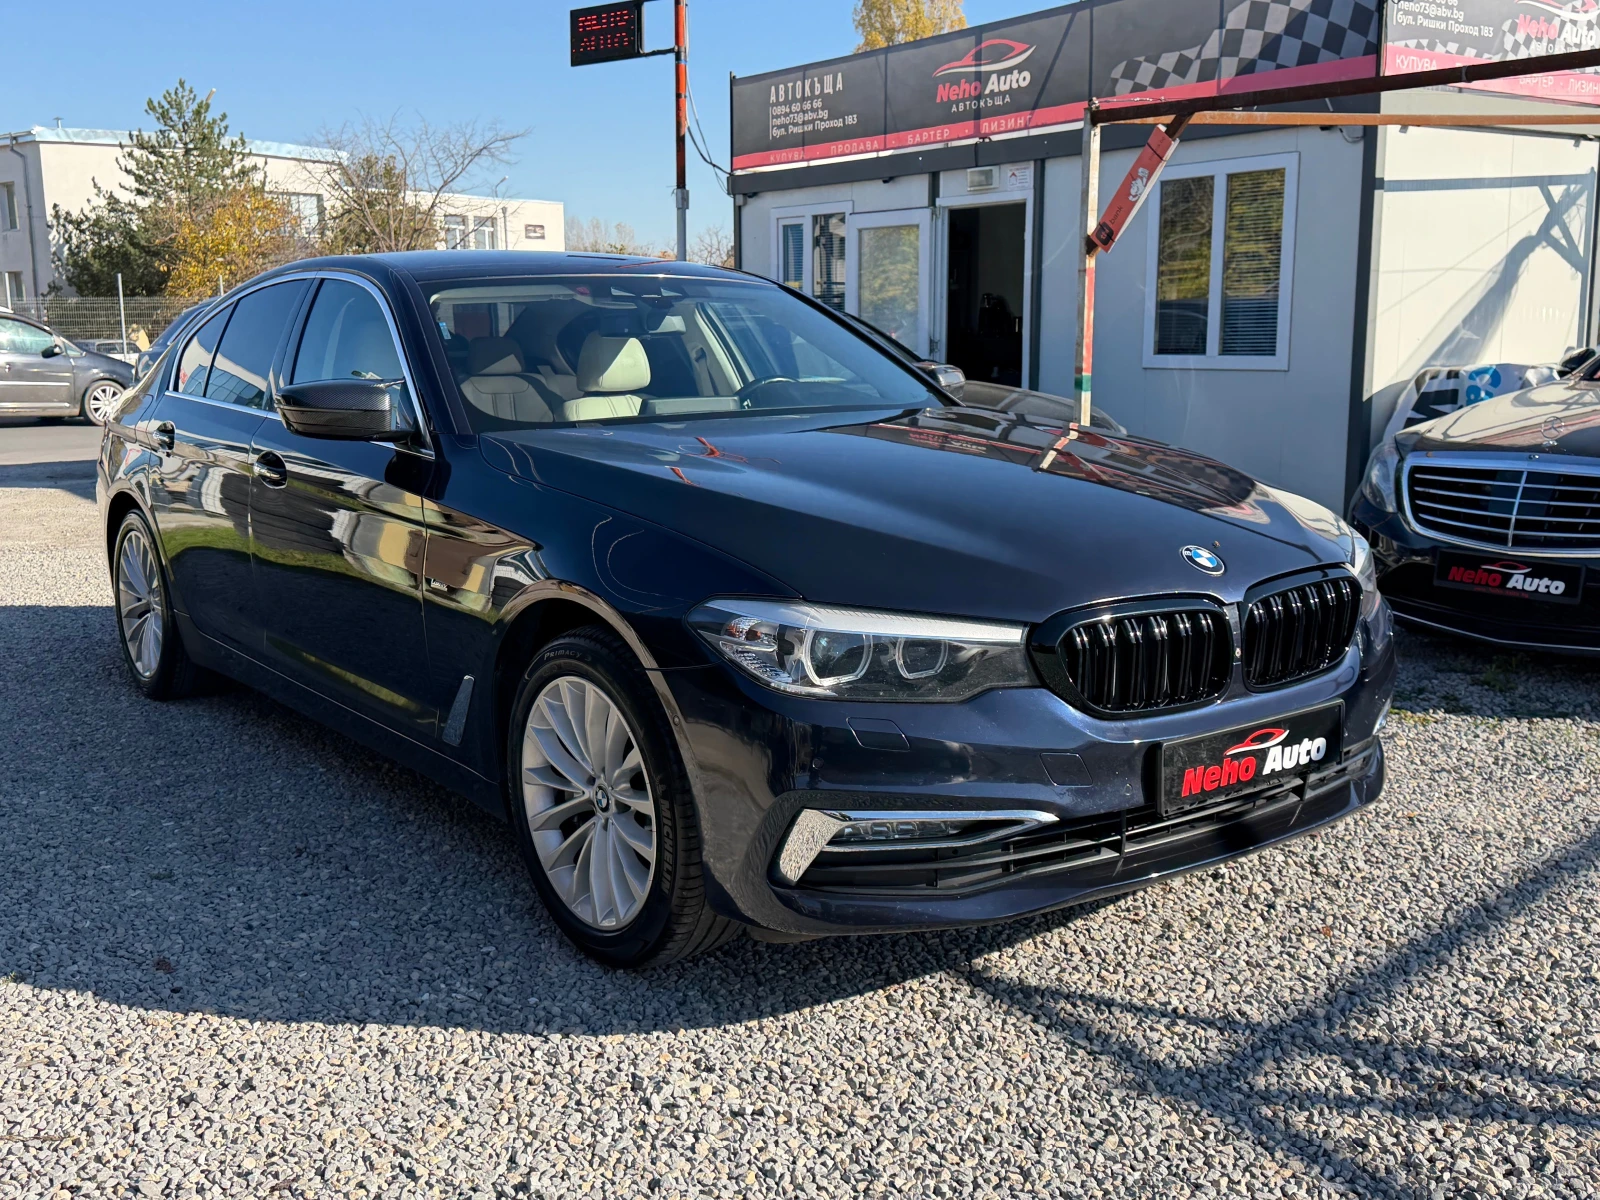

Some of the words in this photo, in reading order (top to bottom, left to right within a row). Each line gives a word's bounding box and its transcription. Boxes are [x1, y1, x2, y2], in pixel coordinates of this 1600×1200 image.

[1397, 11, 1415, 26] бул.
[1417, 15, 1447, 30] Ришки
[1448, 20, 1479, 37] Проход
[1480, 25, 1494, 38] 183
[1517, 13, 1558, 40] Neho
[1560, 21, 1597, 46] Auto
[1395, 53, 1438, 71] КУПУВА
[770, 72, 843, 104] АВТОКЪЩА
[936, 78, 981, 103] Neho
[984, 69, 1031, 95] Auto
[772, 105, 790, 116] 0894
[791, 102, 801, 113] 60
[802, 100, 812, 110] 66
[812, 98, 823, 108] 66
[951, 94, 1011, 113] АВТОКЪЩА
[772, 109, 829, 126] neho73@abv.bg
[772, 126, 787, 139] бул.
[788, 123, 813, 135] Ришки
[814, 118, 844, 132] Проход
[844, 114, 858, 126] 183
[770, 151, 805, 163] КУПУВА
[830, 140, 879, 155] ПРОДАВА
[907, 128, 950, 145] БАРТЕР
[981, 115, 1033, 134] ЛИЗИНГ
[1109, 205, 1124, 224] bank
[1448, 566, 1502, 587] Neho
[1506, 573, 1566, 595] Auto
[543, 649, 583, 661] PRIMACY
[1181, 756, 1257, 798] Neho
[1262, 736, 1327, 776] Auto
[660, 799, 674, 896] MICHELIN
